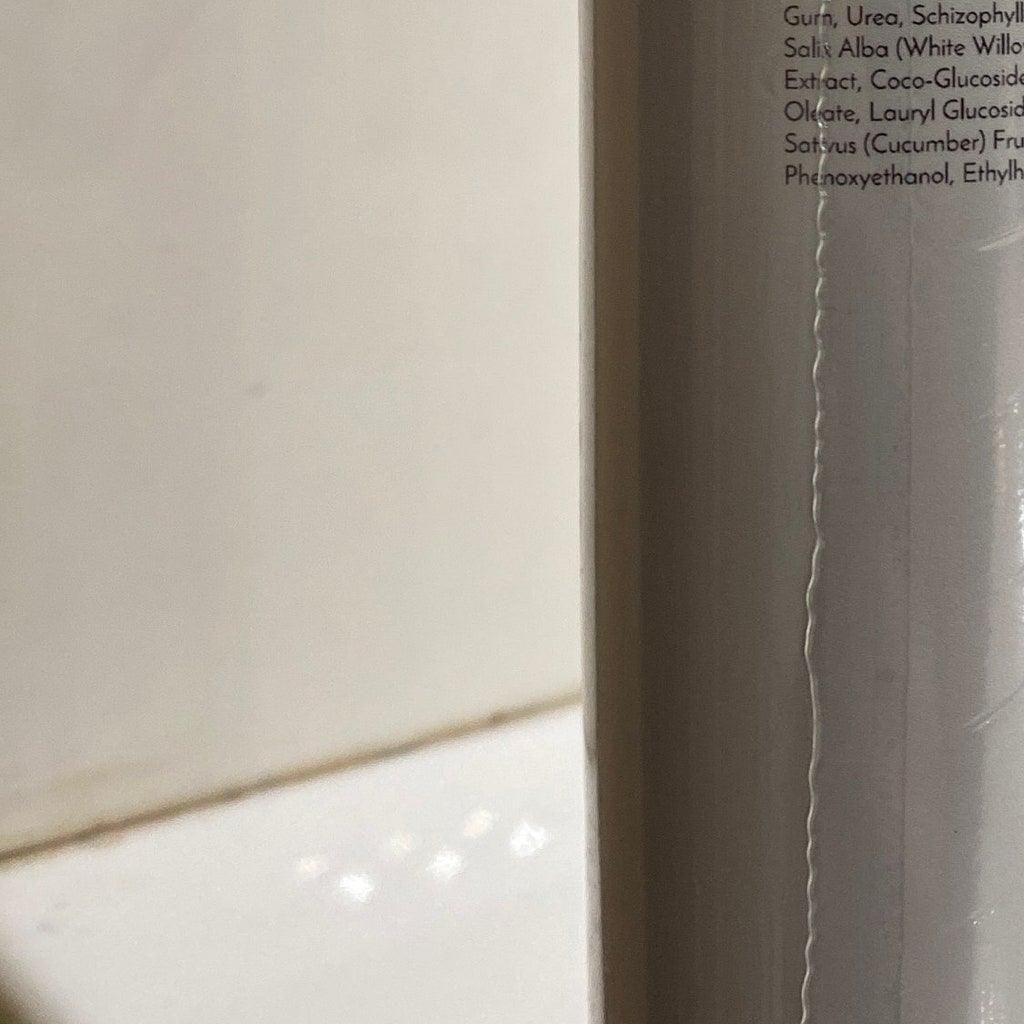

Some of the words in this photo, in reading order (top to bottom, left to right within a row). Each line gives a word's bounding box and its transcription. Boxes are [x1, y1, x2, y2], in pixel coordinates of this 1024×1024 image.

[847, 5, 902, 27] Urea,
[839, 37, 888, 58] Alba
[896, 35, 964, 60] (White
[870, 99, 934, 125] Lauryl
[785, 132, 856, 154] Satvus
[864, 129, 985, 156] (Cucumber)
[785, 163, 954, 190] Phenoxyethanol,
